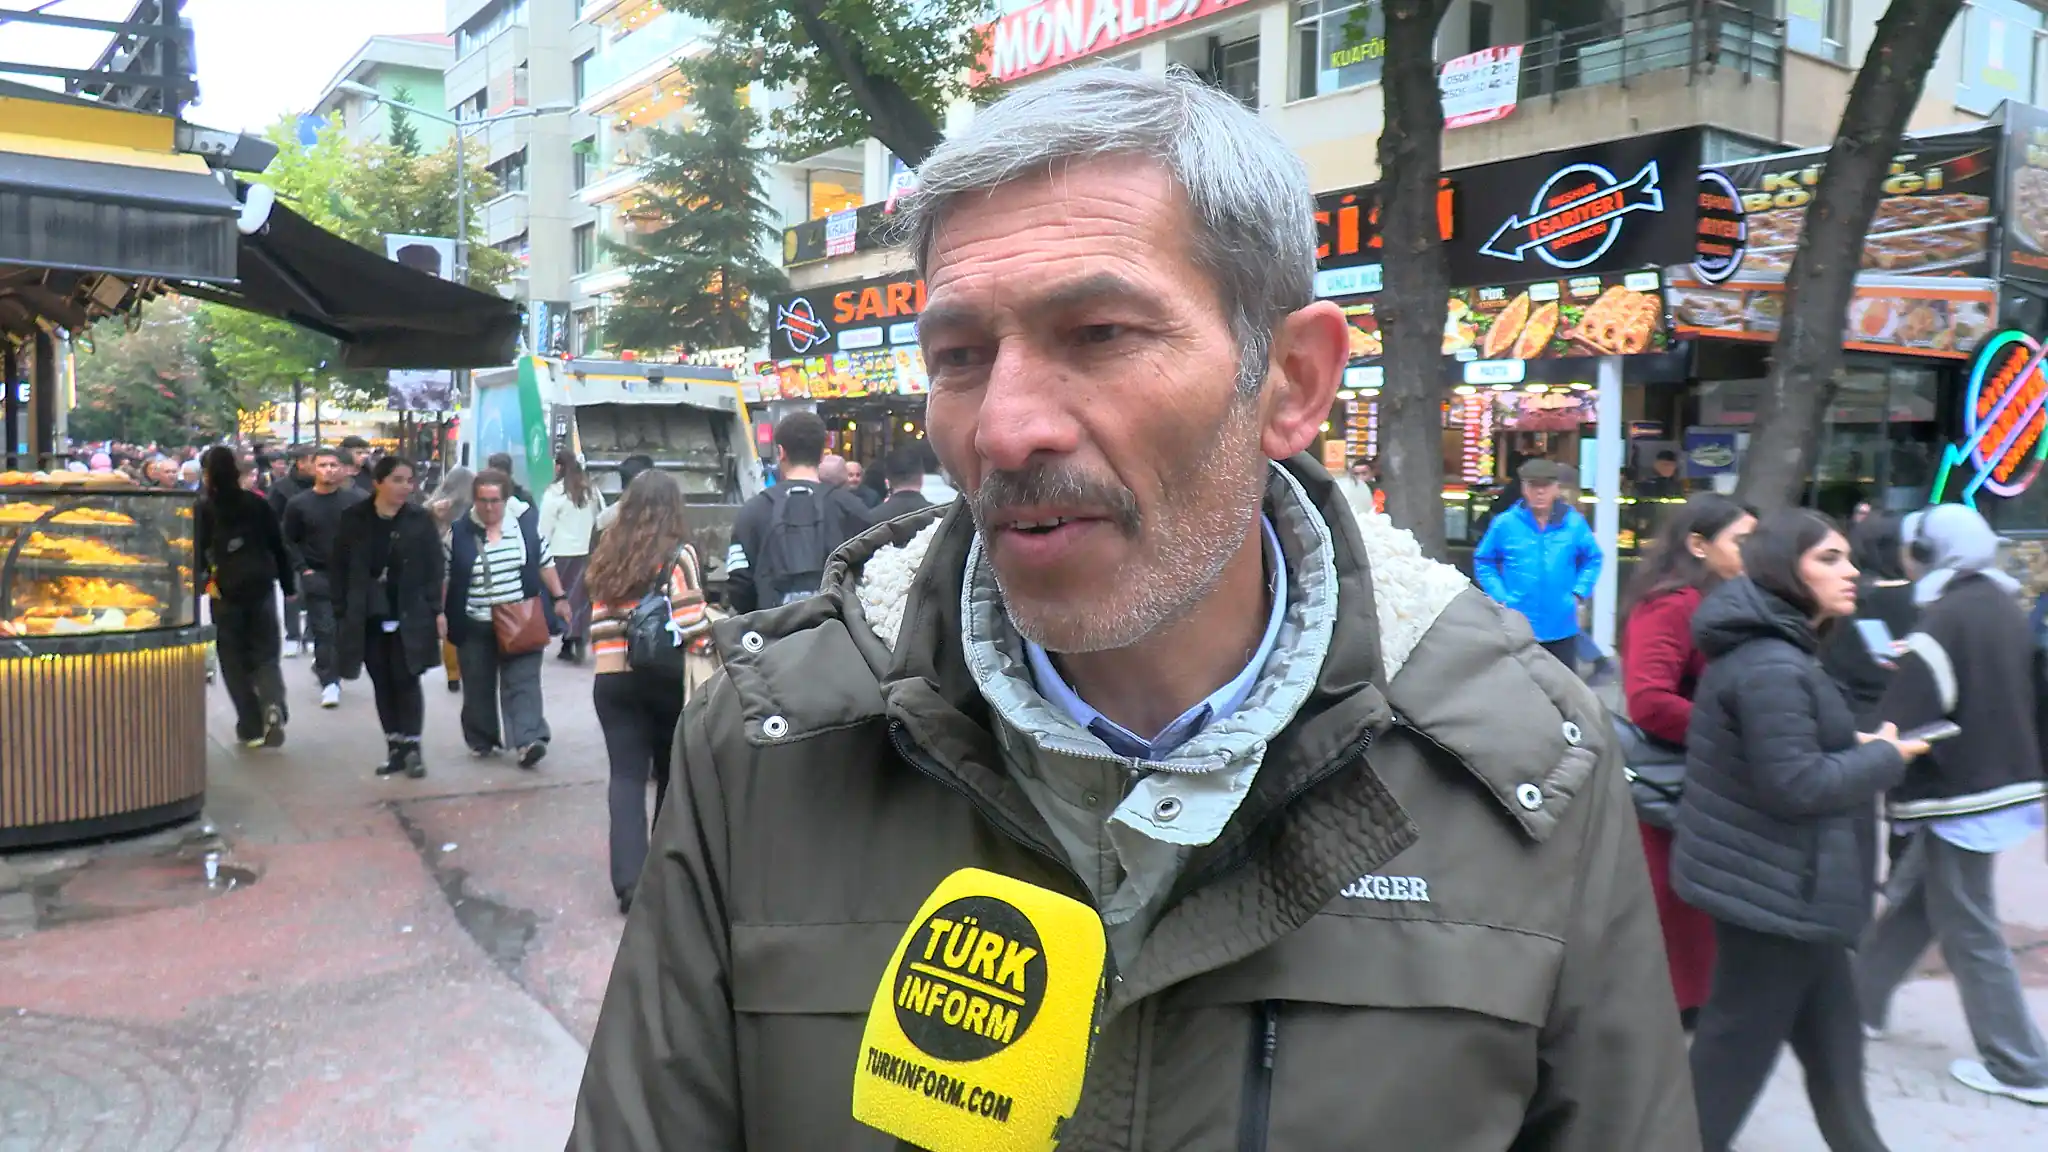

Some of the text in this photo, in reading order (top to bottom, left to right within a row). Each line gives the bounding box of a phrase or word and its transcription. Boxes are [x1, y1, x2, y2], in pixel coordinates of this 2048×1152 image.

[992, 0, 1228, 78] MONAL
[1538, 195, 1617, 237] SARIYER
[923, 915, 1038, 993] TÜRK
[897, 974, 1020, 1044] INFORM
[865, 1046, 1014, 1123] TURKINFORM.COM
